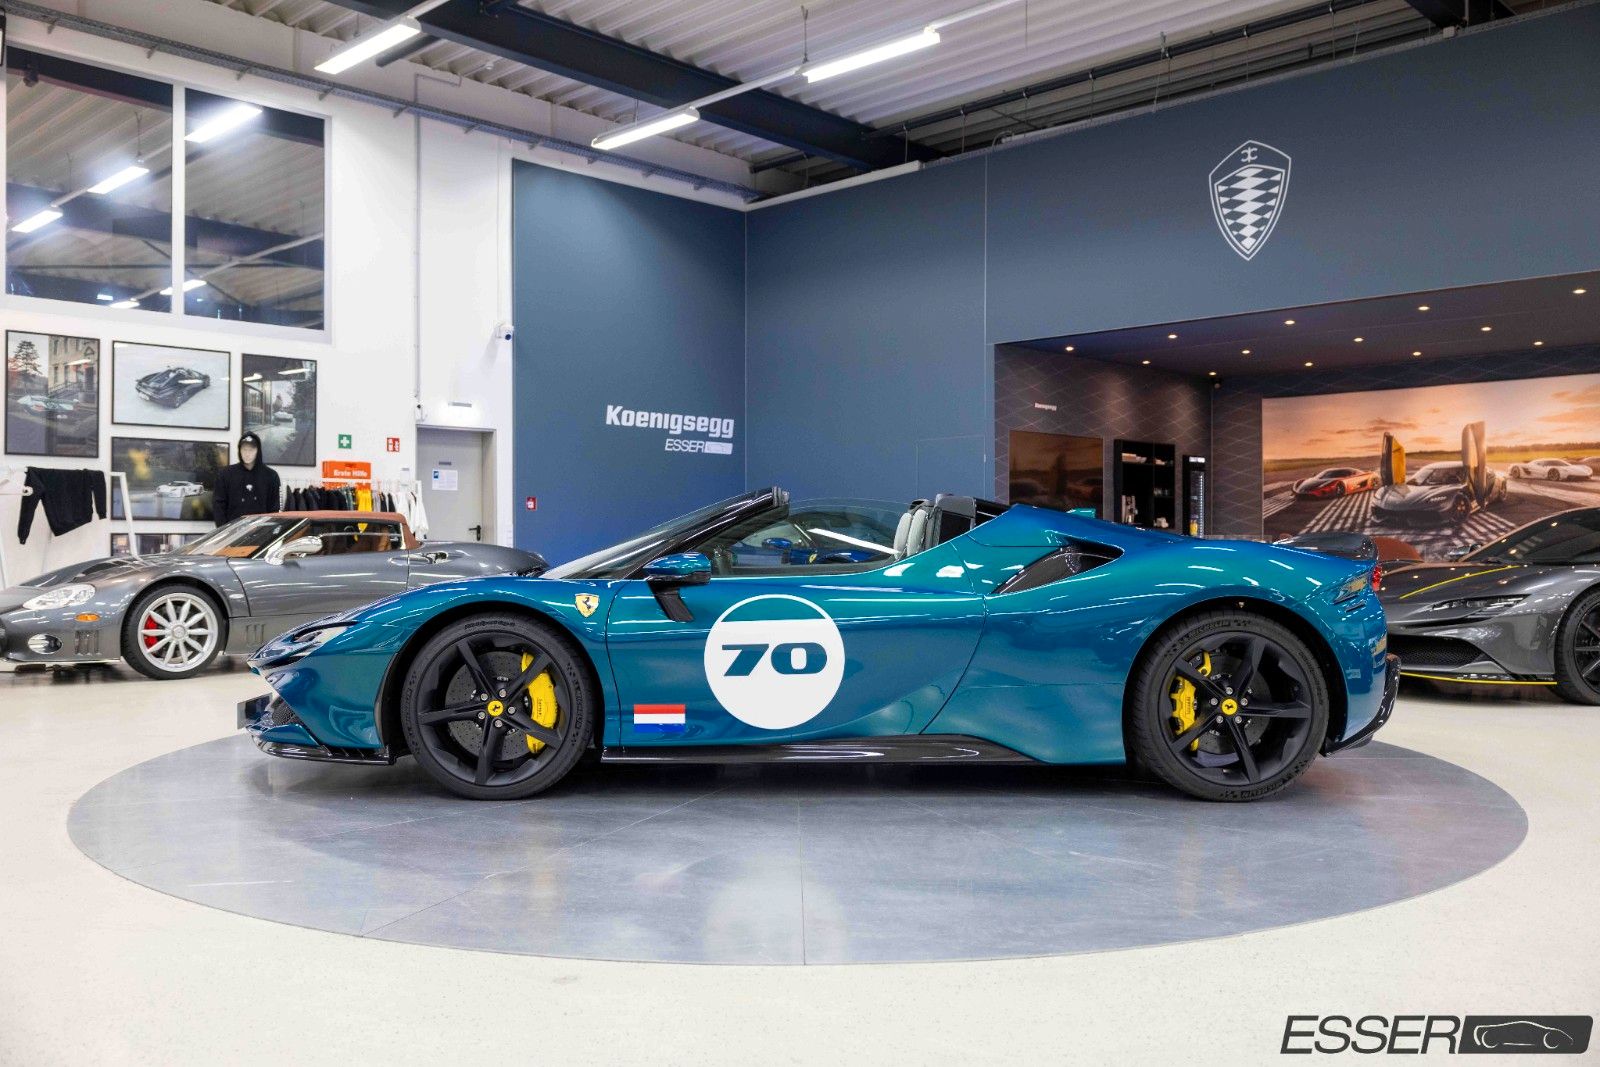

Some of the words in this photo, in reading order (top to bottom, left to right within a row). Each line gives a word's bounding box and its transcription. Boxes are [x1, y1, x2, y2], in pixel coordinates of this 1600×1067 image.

[605, 404, 735, 439] Koenigsegg
[664, 438, 705, 453] ESSER
[721, 642, 828, 677] 70
